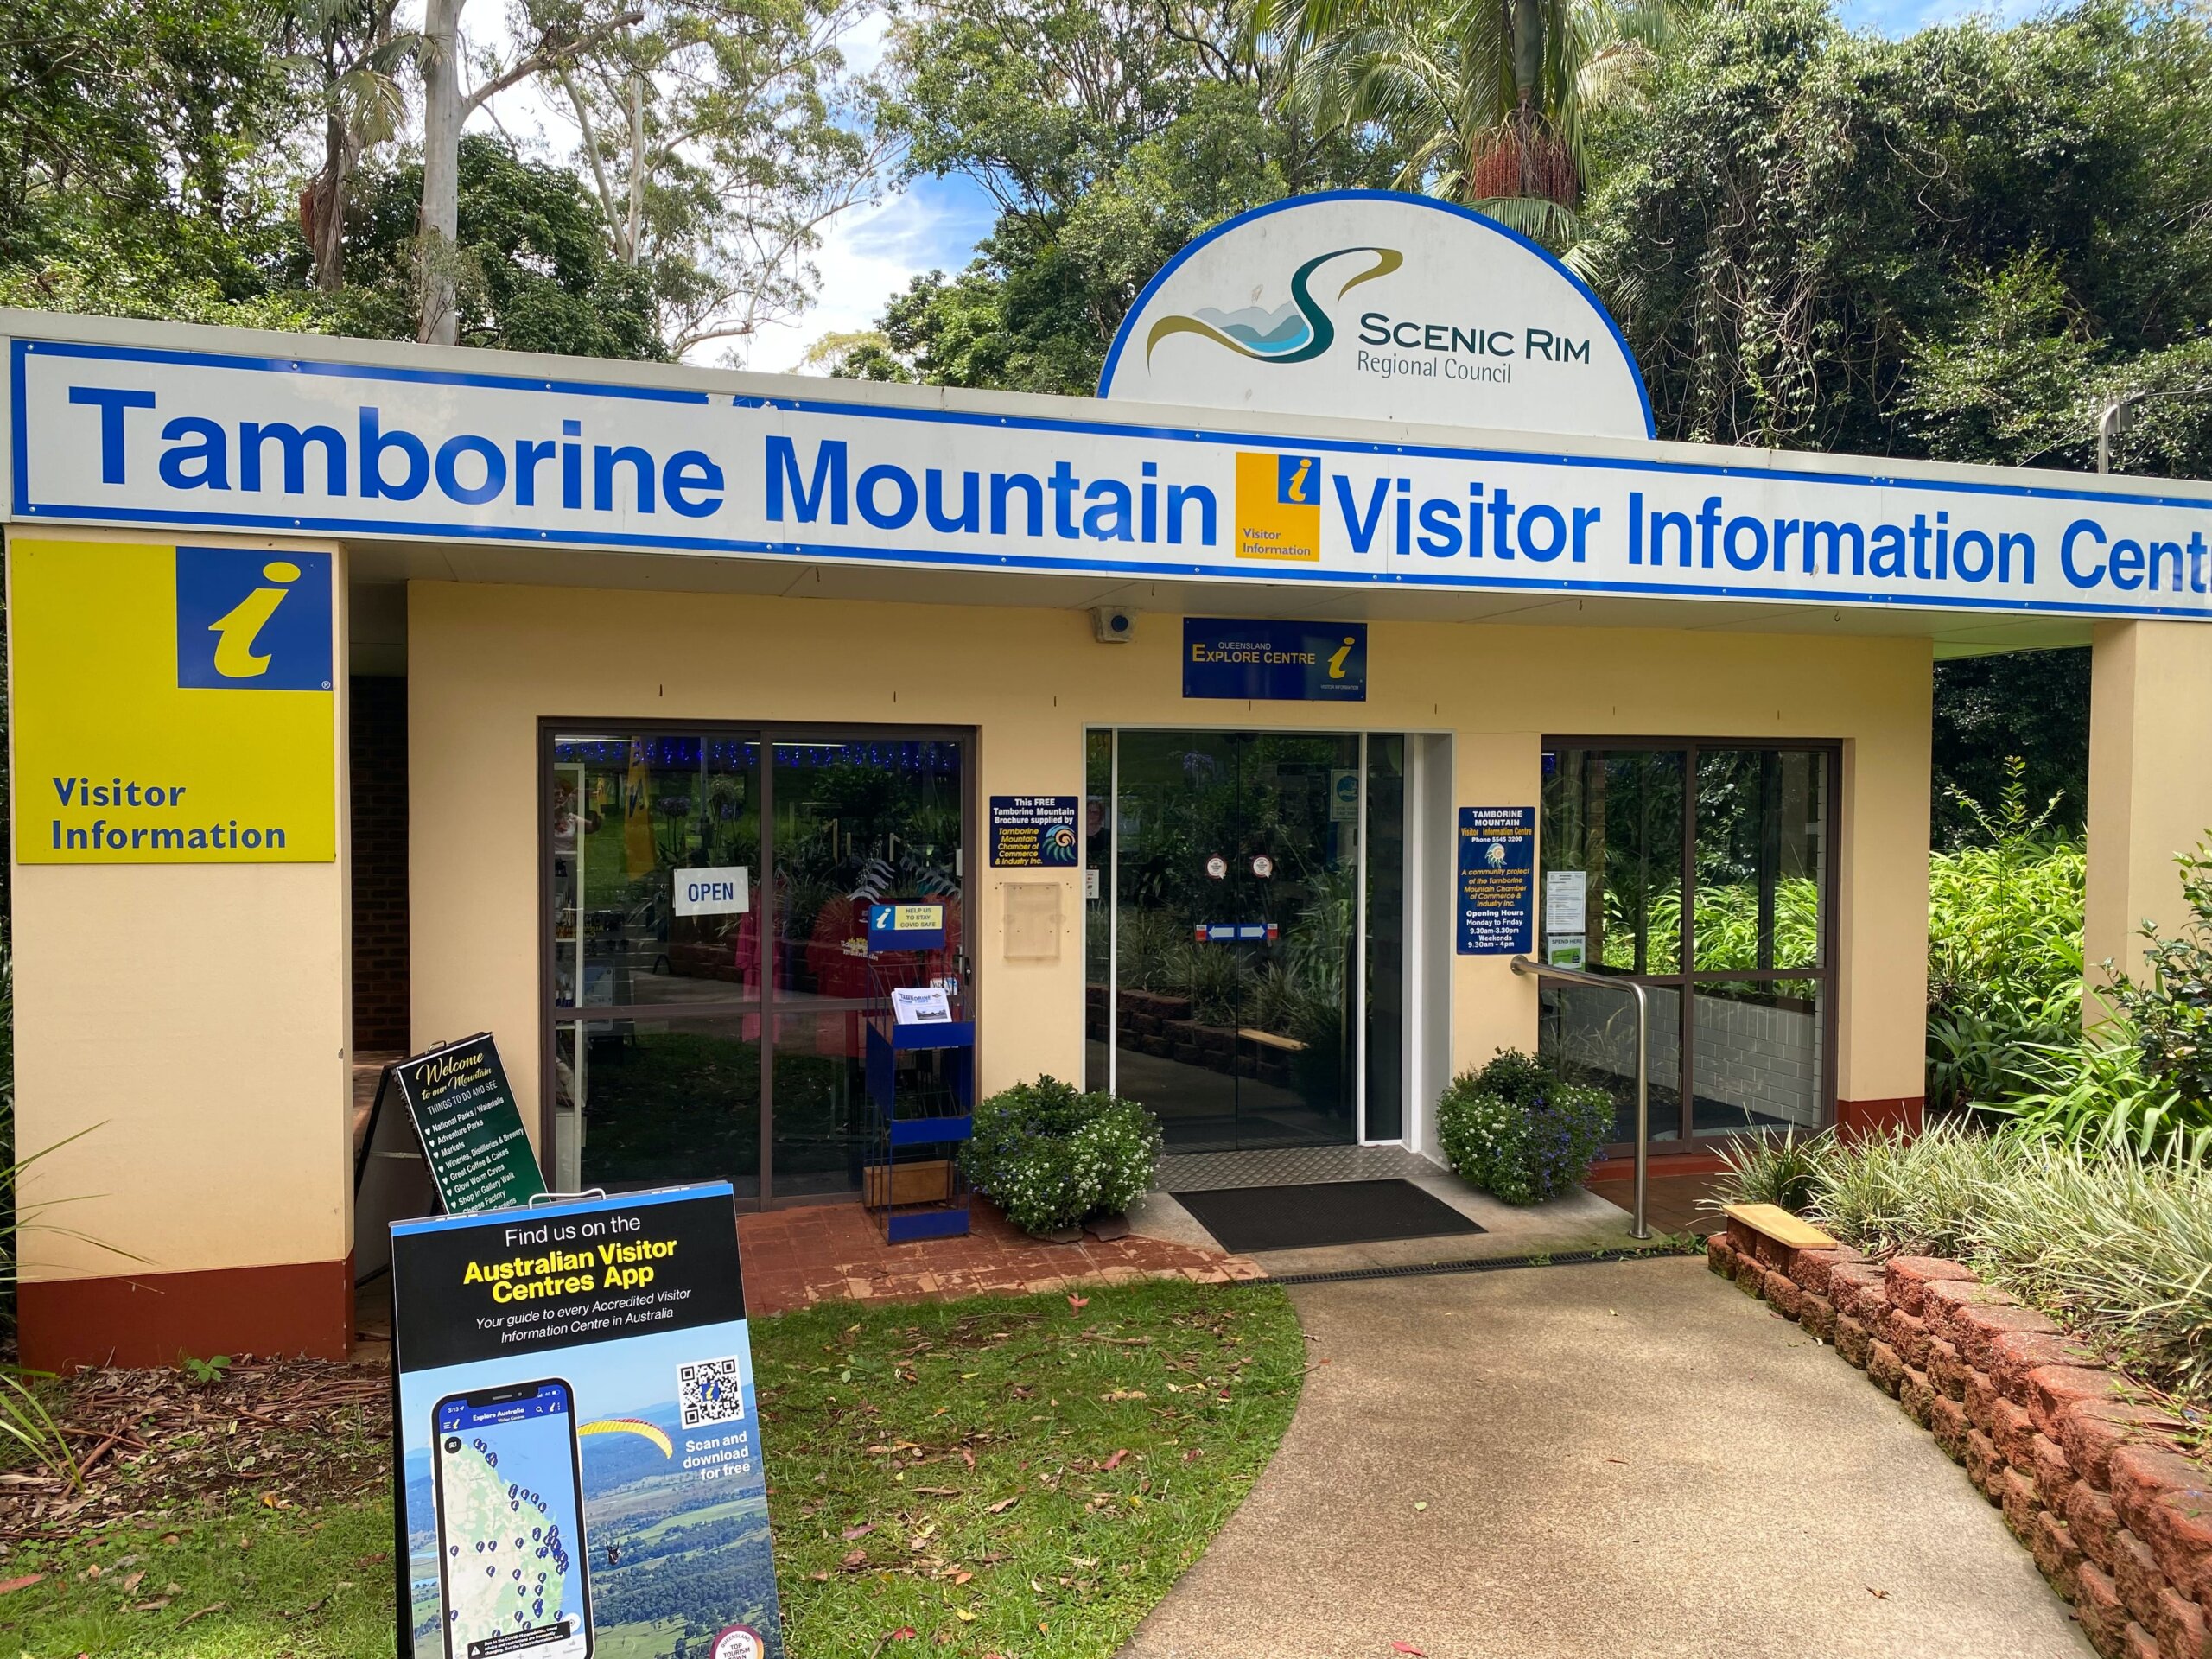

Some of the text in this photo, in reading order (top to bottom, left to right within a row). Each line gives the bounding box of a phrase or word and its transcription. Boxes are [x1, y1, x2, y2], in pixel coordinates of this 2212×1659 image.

[1358, 312, 1591, 365] SCENIC RIM
[1357, 349, 1511, 383] Regional Council
[68, 385, 1217, 546] Tamborine Mountain
[1243, 527, 1281, 540] Visitor
[1332, 474, 2212, 594] Visitor Information Cent
[1243, 542, 1312, 556] Information
[1192, 643, 1316, 664] EXPLORE CENTRE
[1218, 642, 1271, 651] QUEENSLAND
[53, 777, 187, 807] Visitor
[52, 820, 287, 849] Information
[1031, 816, 1062, 825] supplied
[1064, 817, 1073, 825] by
[1461, 828, 1479, 836] Visitor
[1483, 828, 1513, 836] Information
[1506, 868, 1529, 876] project
[688, 882, 734, 902] OPEN
[1502, 918, 1522, 927] Friday
[416, 1052, 484, 1086] Welcome
[421, 1068, 492, 1101] to our Mountain
[427, 1080, 499, 1116] THINGS TO DO AND SEE
[432, 1096, 505, 1133] National Parks Waterfalls
[437, 1119, 484, 1145] Adventure Parks
[471, 1139, 499, 1157] Distilleries
[499, 1136, 504, 1145] &
[503, 1127, 524, 1141] Brewery
[441, 1141, 466, 1157] Markets
[449, 1168, 467, 1181] Great
[467, 1159, 486, 1173] Coffee
[491, 1147, 509, 1160] Cakes
[454, 1164, 505, 1193] Glow Worm Caves
[458, 1193, 475, 1206] Shop
[480, 1179, 501, 1194] Gallery
[500, 1172, 515, 1184] Walk
[484, 1190, 505, 1205] Factory
[505, 1215, 641, 1247] Find us on the
[463, 1240, 677, 1285] Australian Visitor
[492, 1265, 654, 1304] Centres App
[476, 1288, 692, 1330] Your guide to every Accredited Visitor
[501, 1307, 674, 1344] Information Centre in Australia
[473, 1408, 524, 1421] Explore Australia
[685, 1430, 747, 1452] Scan and
[683, 1445, 749, 1469] download
[701, 1462, 751, 1480] for free
[721, 1633, 751, 1648] QUEENSLAND
[723, 1647, 750, 1658] TOURISM
